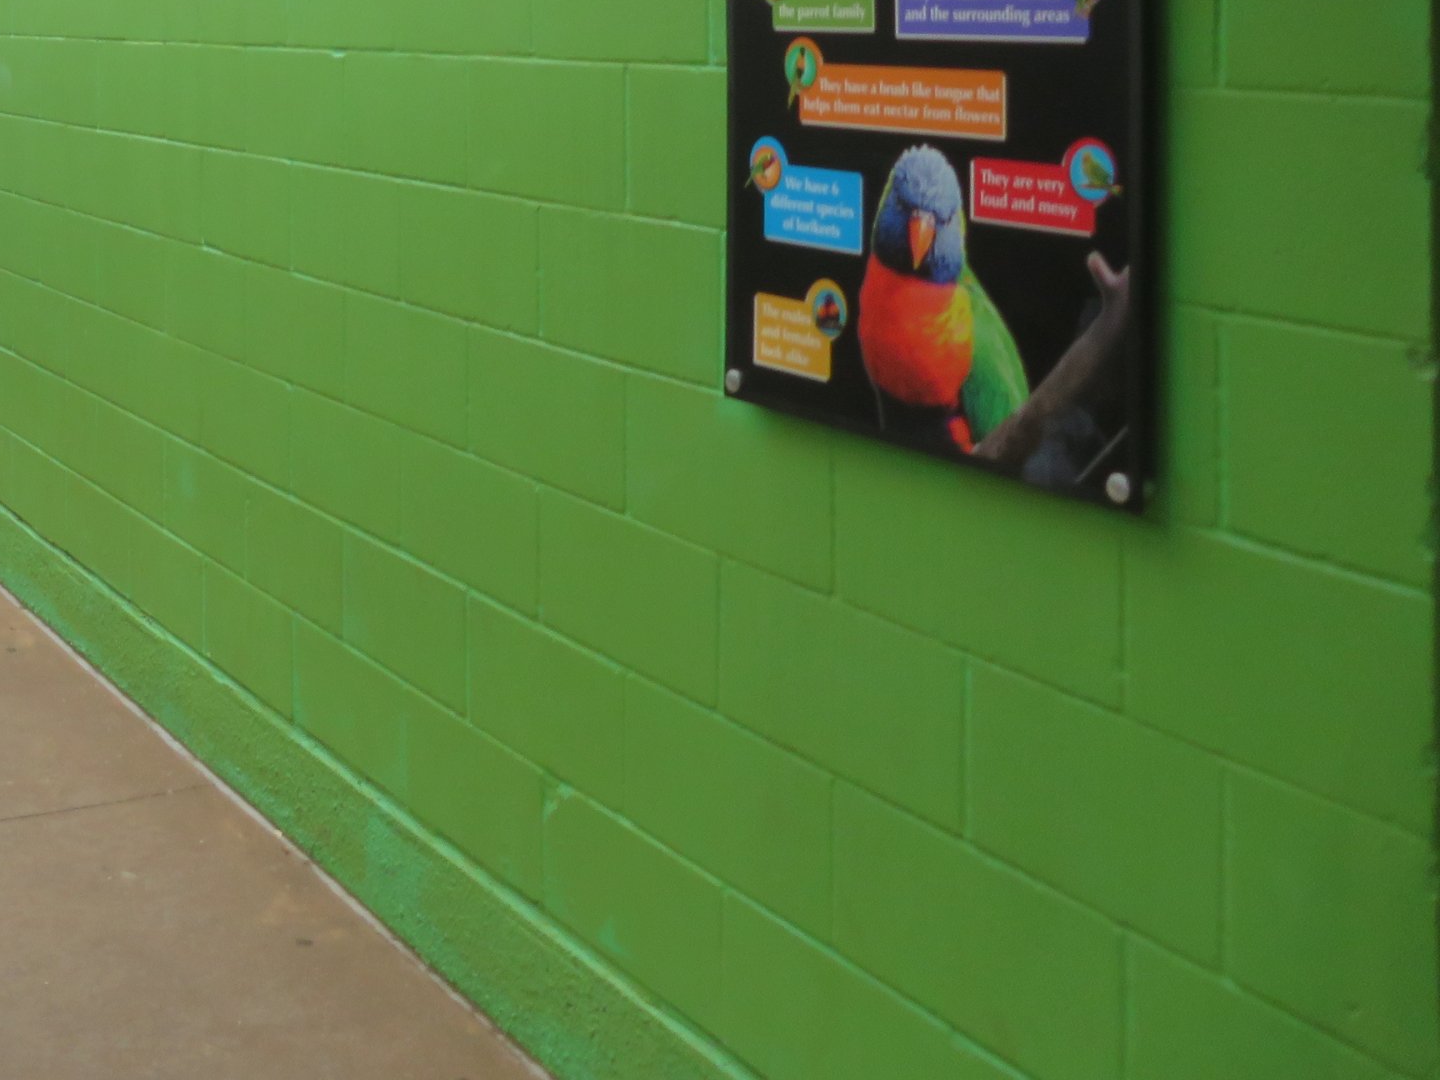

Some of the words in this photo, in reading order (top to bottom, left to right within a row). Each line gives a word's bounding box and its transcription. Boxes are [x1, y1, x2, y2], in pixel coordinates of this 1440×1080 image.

[779, 3, 794, 17] the
[797, 4, 830, 22] parrot
[832, 3, 865, 22] family
[905, 5, 927, 21] and
[930, 4, 949, 21] the
[953, 4, 1031, 27] surrounding
[1033, 8, 1070, 24] areas
[820, 77, 841, 94] They
[844, 79, 868, 94] have
[870, 83, 877, 95] a
[879, 80, 909, 97] brush
[912, 81, 931, 98] like
[934, 84, 973, 104] tongue
[977, 84, 1000, 102] that
[803, 96, 830, 116] helps
[833, 98, 860, 114] them
[863, 103, 880, 116] eat
[883, 103, 918, 118] nectar
[923, 104, 951, 120] from
[955, 105, 1000, 124] flowers
[785, 175, 802, 190] We
[804, 176, 829, 195] have
[981, 168, 1008, 189] They
[1013, 176, 1033, 190] are
[1037, 178, 1065, 196] very
[770, 193, 814, 213] different
[816, 201, 854, 219] species
[980, 190, 1008, 208] loud
[1011, 194, 1035, 212] and
[1039, 201, 1078, 221] messy
[783, 216, 794, 231] of
[796, 216, 840, 238] lorikeets
